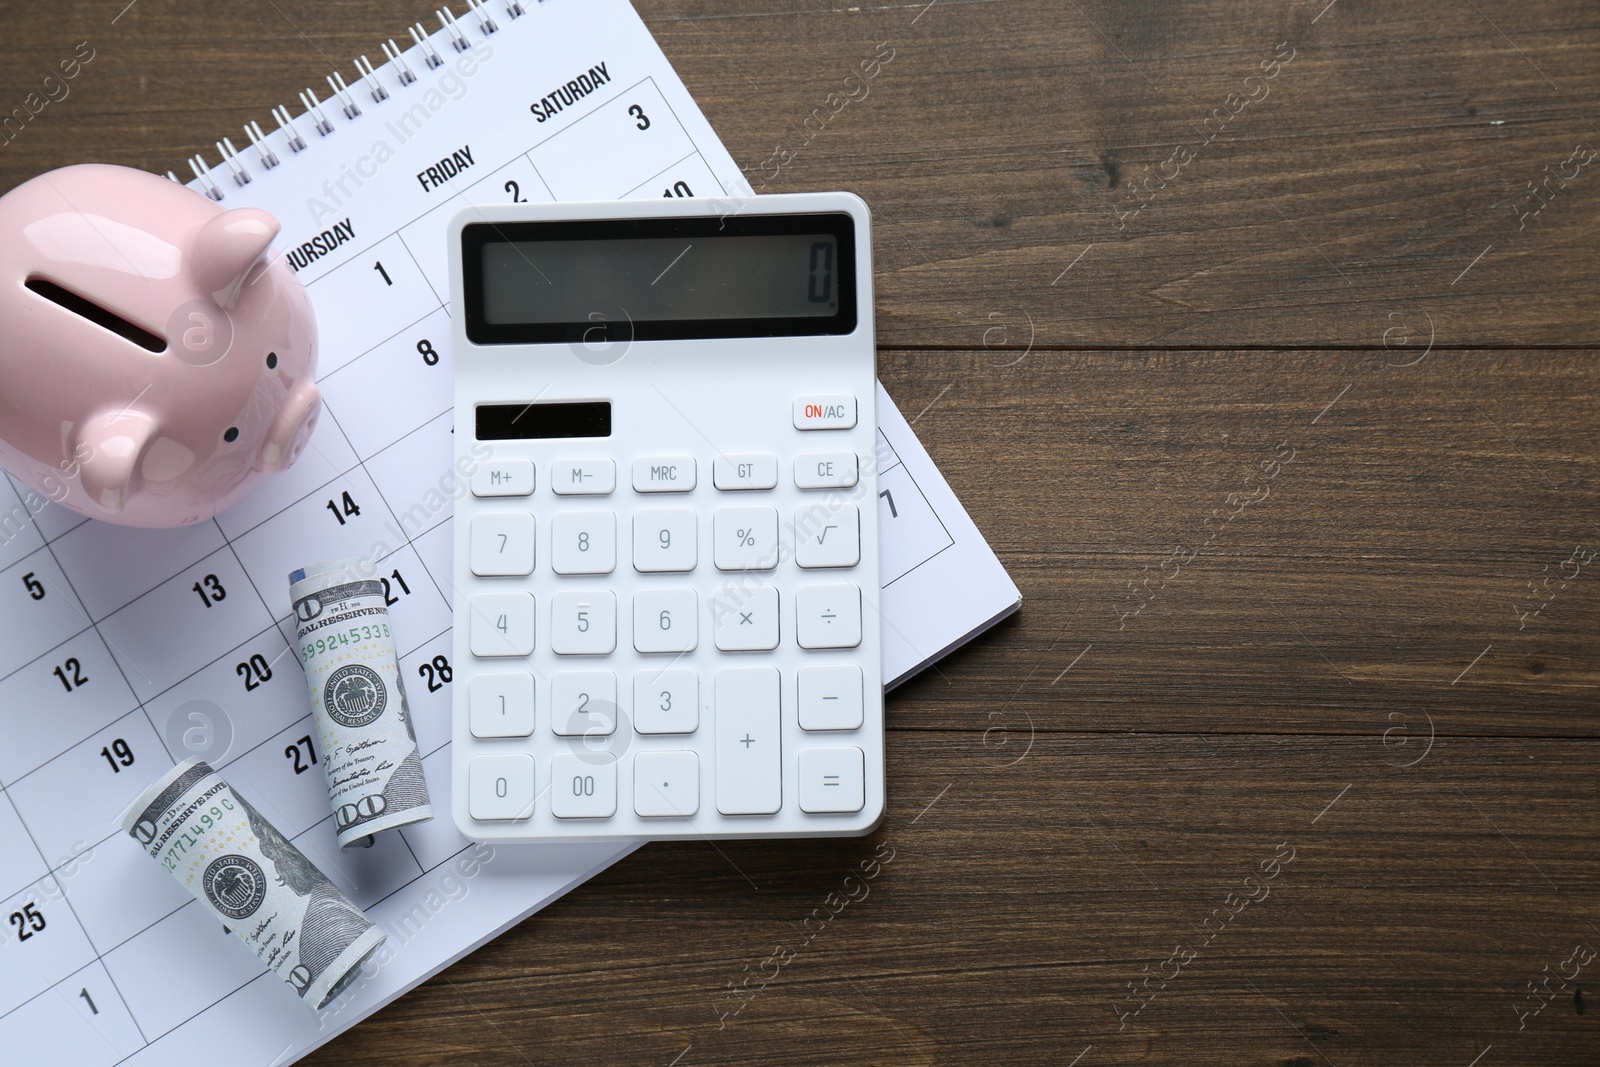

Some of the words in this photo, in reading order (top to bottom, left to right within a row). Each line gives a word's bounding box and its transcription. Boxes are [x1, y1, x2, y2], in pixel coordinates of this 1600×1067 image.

[530, 61, 611, 123] SATURDAY
[628, 104, 651, 131] 3
[416, 145, 475, 193] FRIDAY
[504, 180, 528, 203] 2
[285, 216, 356, 272] HURSDAY
[373, 261, 393, 287] 1
[416, 339, 440, 367] 8
[804, 404, 845, 419] ON/AC
[490, 470, 513, 486] M+
[650, 465, 677, 481] MRC
[737, 463, 754, 479] GT
[817, 461, 834, 477] CE
[326, 490, 361, 526] 14
[497, 533, 508, 554] 7
[578, 531, 590, 552] 8
[659, 529, 671, 550] 9
[22, 572, 45, 601] 5
[192, 574, 226, 608] 13
[379, 569, 411, 608] 21
[319, 607, 374, 630] RESERVE
[496, 614, 508, 634] 4
[577, 611, 589, 633] 5
[659, 610, 671, 631] 6
[53, 657, 89, 692] 12
[236, 653, 273, 692] 20
[328, 670, 349, 691] UNITED
[349, 667, 374, 679] STATES
[418, 654, 453, 694] 28
[498, 694, 506, 716] 1
[577, 692, 590, 714] 2
[660, 690, 672, 712] 3
[347, 711, 377, 725] RESERVE
[100, 739, 135, 774] 19
[285, 734, 318, 775] 27
[495, 777, 507, 799] 0
[572, 775, 595, 797] 00
[159, 796, 207, 844] RESERVE
[202, 781, 228, 801] NOTE
[215, 858, 240, 870] STATES
[9, 901, 47, 942] 25
[79, 987, 99, 1016] 1
